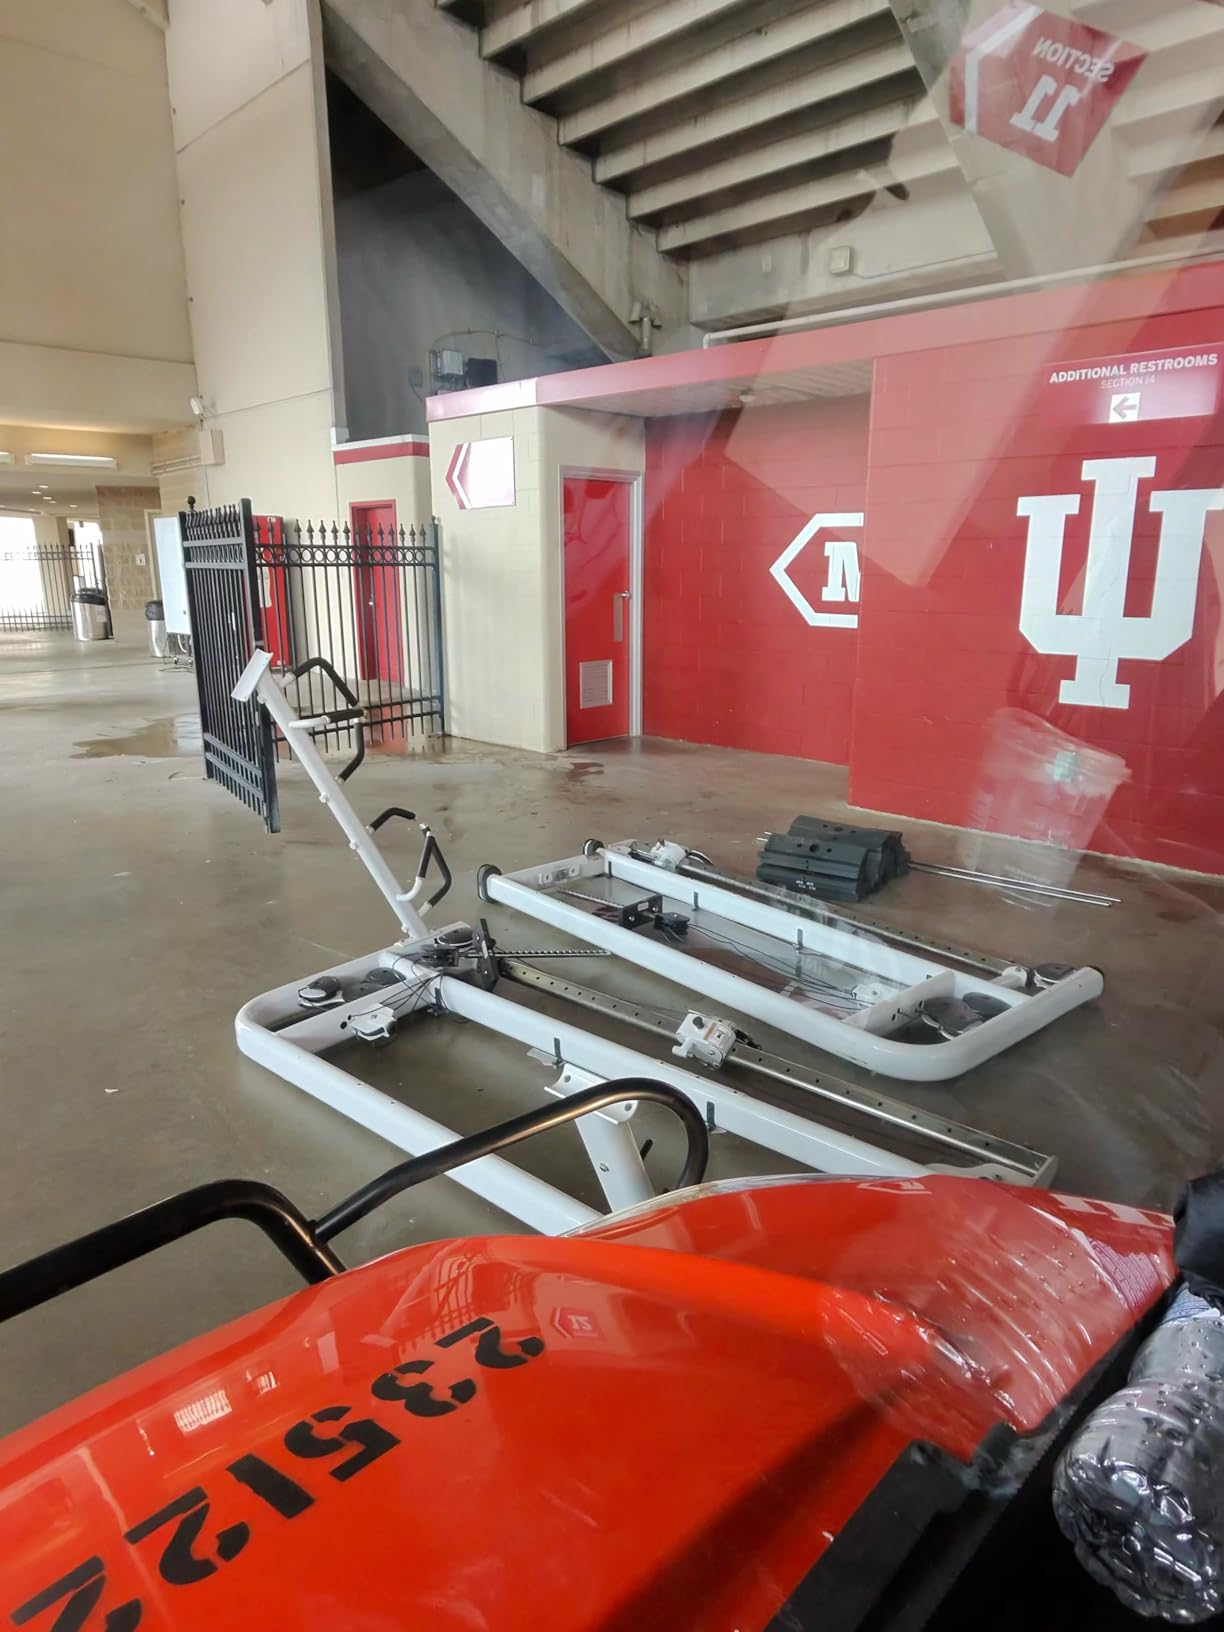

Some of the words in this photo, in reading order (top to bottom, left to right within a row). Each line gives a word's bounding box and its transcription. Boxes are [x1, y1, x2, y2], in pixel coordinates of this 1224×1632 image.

[1049, 364, 1127, 384] ADDITIONAL
[1130, 353, 1219, 375] RESTROOMS
[1100, 375, 1143, 390] SECTION
